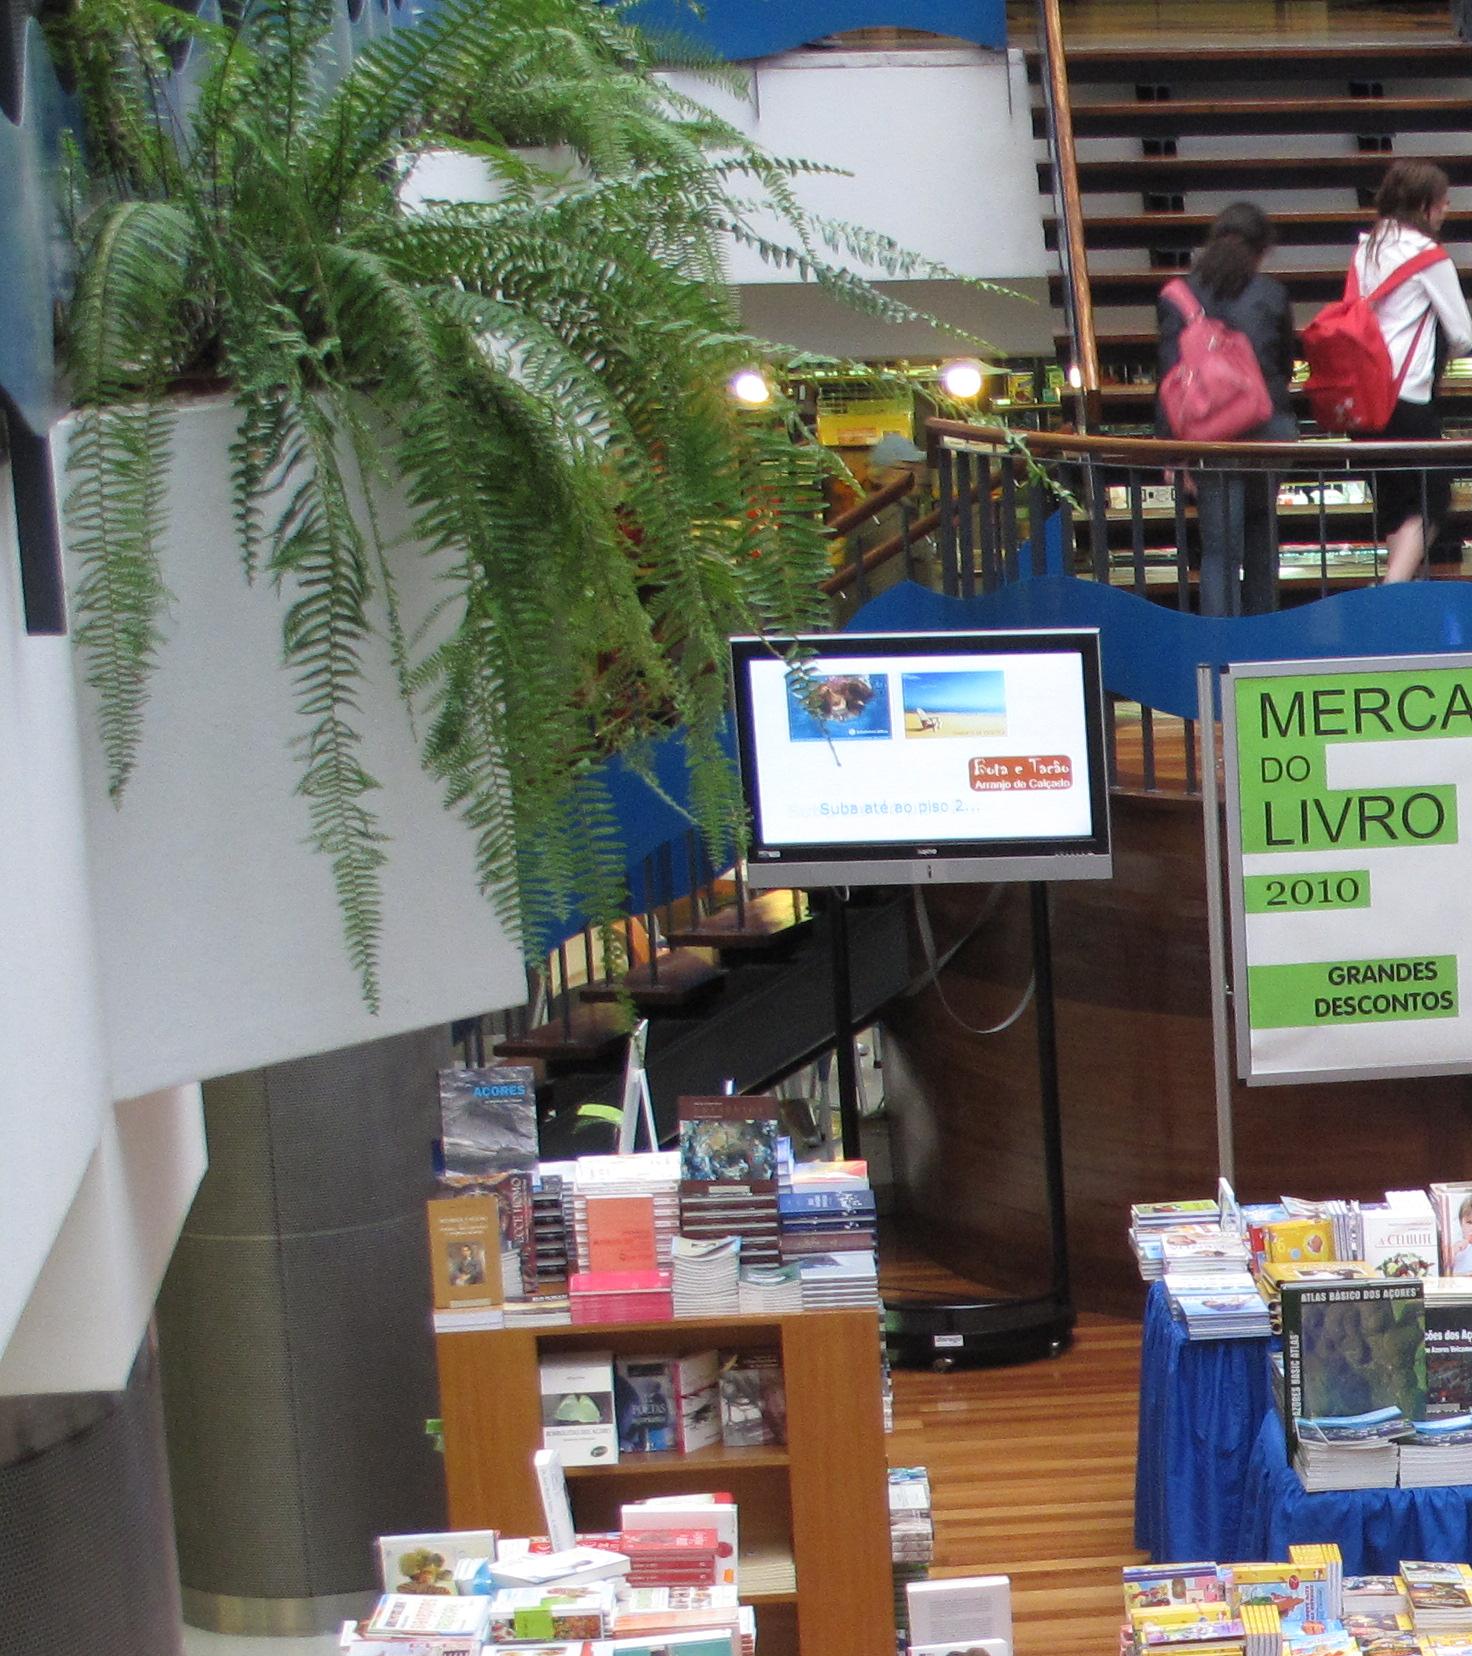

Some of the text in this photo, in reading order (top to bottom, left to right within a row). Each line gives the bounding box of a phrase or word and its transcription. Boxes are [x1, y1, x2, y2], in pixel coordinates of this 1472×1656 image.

[1261, 755, 1311, 783] DO
[975, 778, 1070, 790] Arranjo de Calçado
[820, 802, 858, 816] Suba
[865, 801, 888, 815] até
[895, 804, 912, 814] ao
[919, 801, 949, 816] piso
[1264, 792, 1445, 846] LIVRO
[1266, 876, 1360, 906] 2010
[1328, 961, 1438, 985] GRANDES
[1314, 991, 1454, 1018] DESCONTOS
[510, 1177, 522, 1212] HOMO
[1301, 1287, 1417, 1302] ATLAS BÁSICO DOS AÇORES
[1289, 1334, 1299, 1358] ATLAS
[1445, 1330, 1460, 1340] dos
